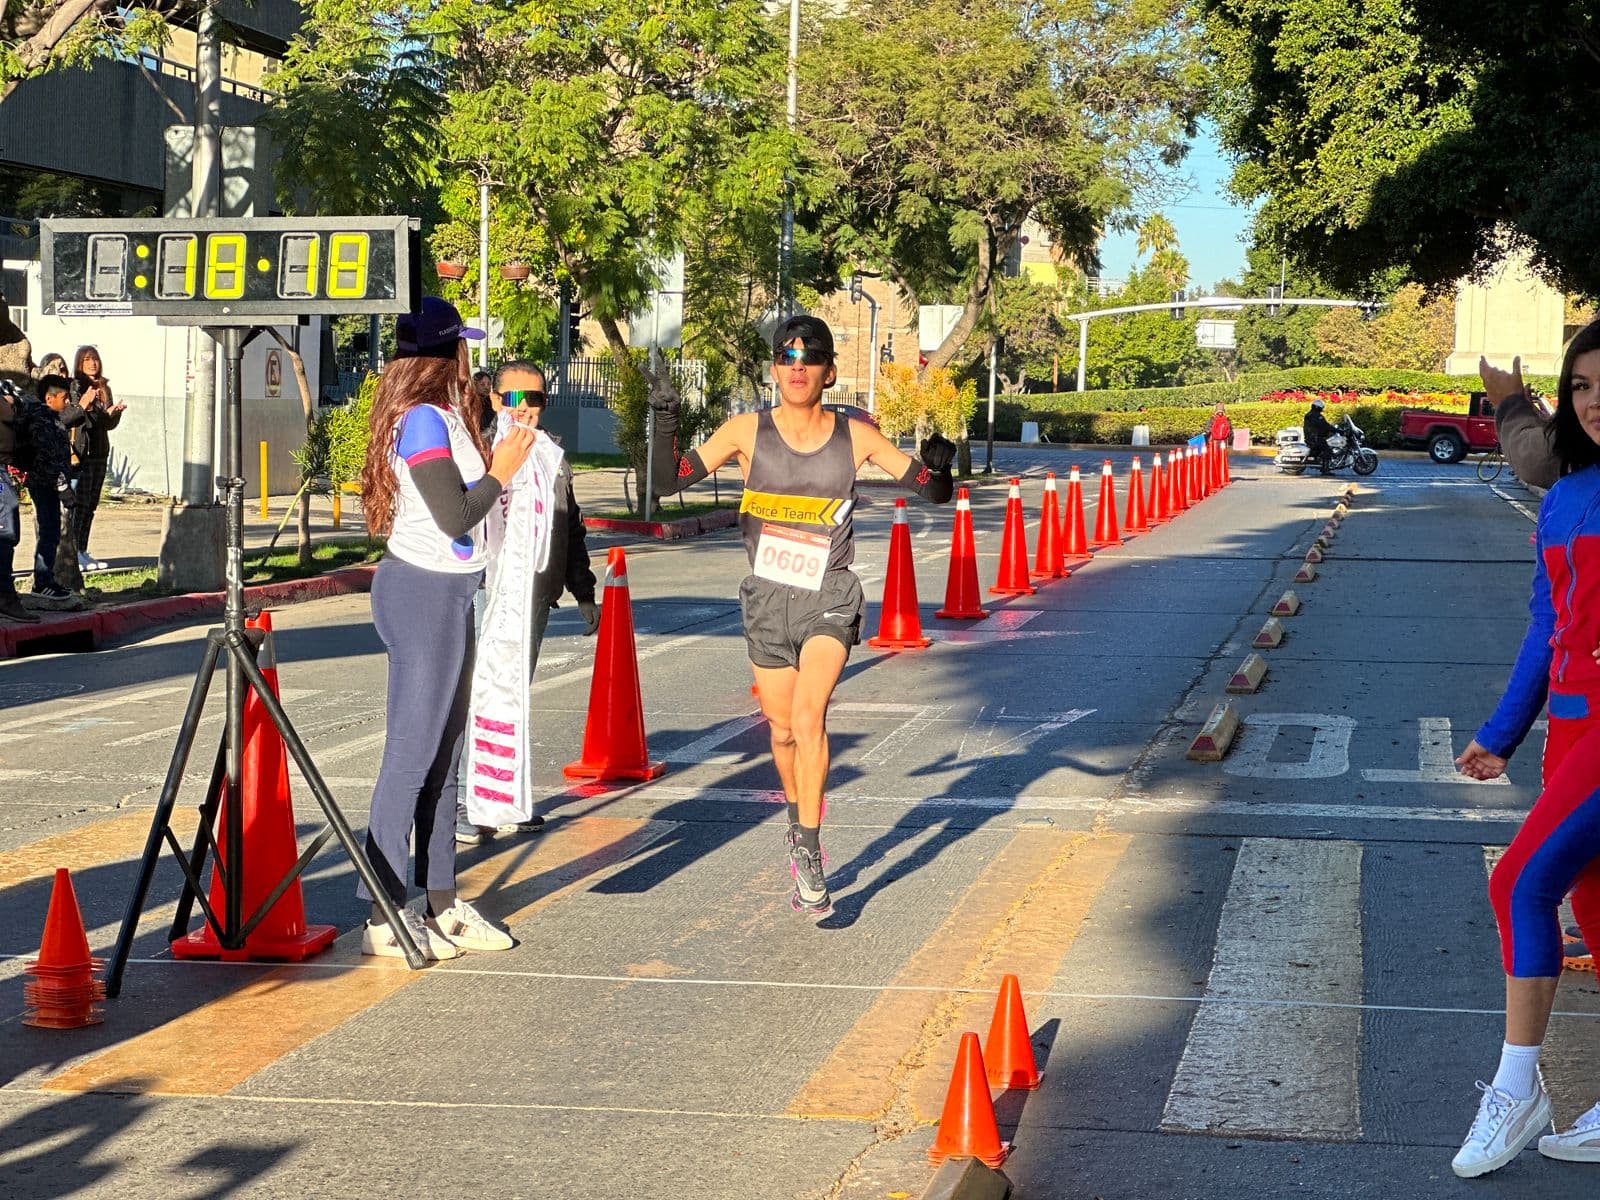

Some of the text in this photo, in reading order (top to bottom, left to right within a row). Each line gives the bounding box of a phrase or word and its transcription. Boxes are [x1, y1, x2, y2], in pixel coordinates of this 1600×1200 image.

[750, 501, 817, 521] Force Team
[762, 545, 820, 577] 0609
